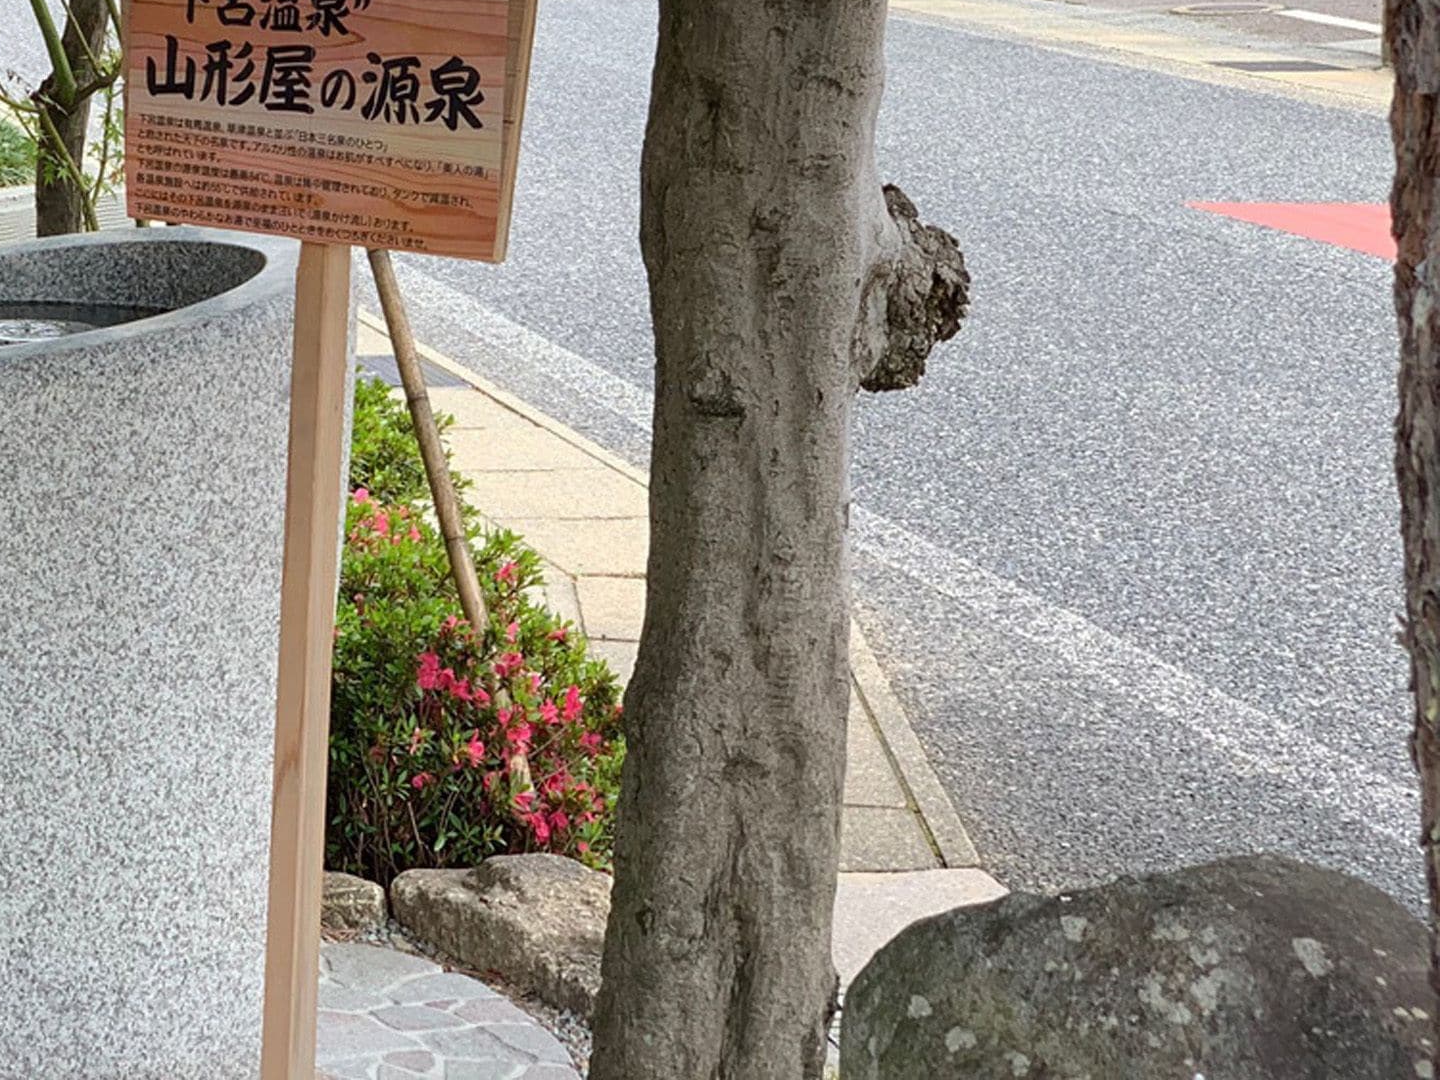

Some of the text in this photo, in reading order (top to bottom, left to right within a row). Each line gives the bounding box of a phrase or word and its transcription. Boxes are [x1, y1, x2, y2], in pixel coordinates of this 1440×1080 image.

[146, 34, 485, 131] 山形屋の源泉
